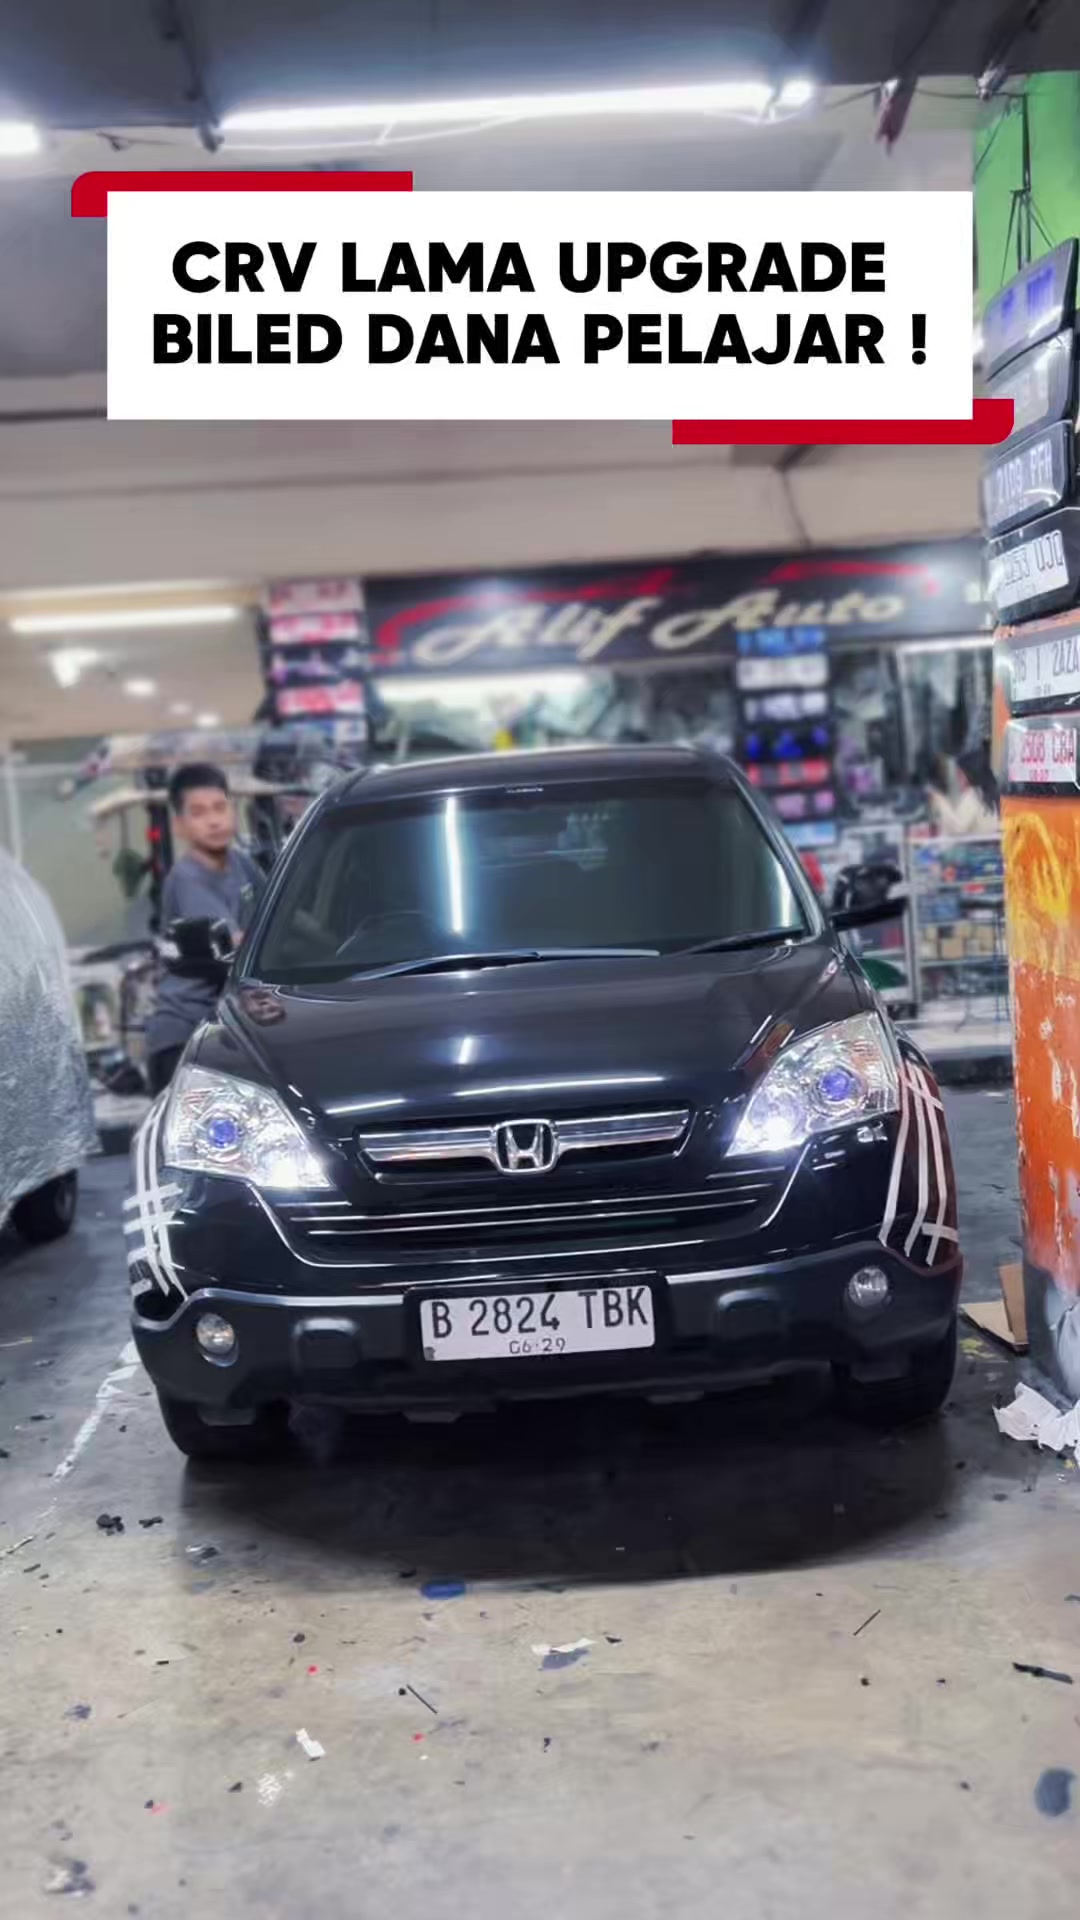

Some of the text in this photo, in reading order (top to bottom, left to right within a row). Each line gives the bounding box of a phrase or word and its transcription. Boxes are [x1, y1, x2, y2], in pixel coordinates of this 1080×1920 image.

[413, 597, 660, 661] Alif
[651, 589, 904, 650] Auto
[431, 1286, 649, 1339] B 2824 TBK
